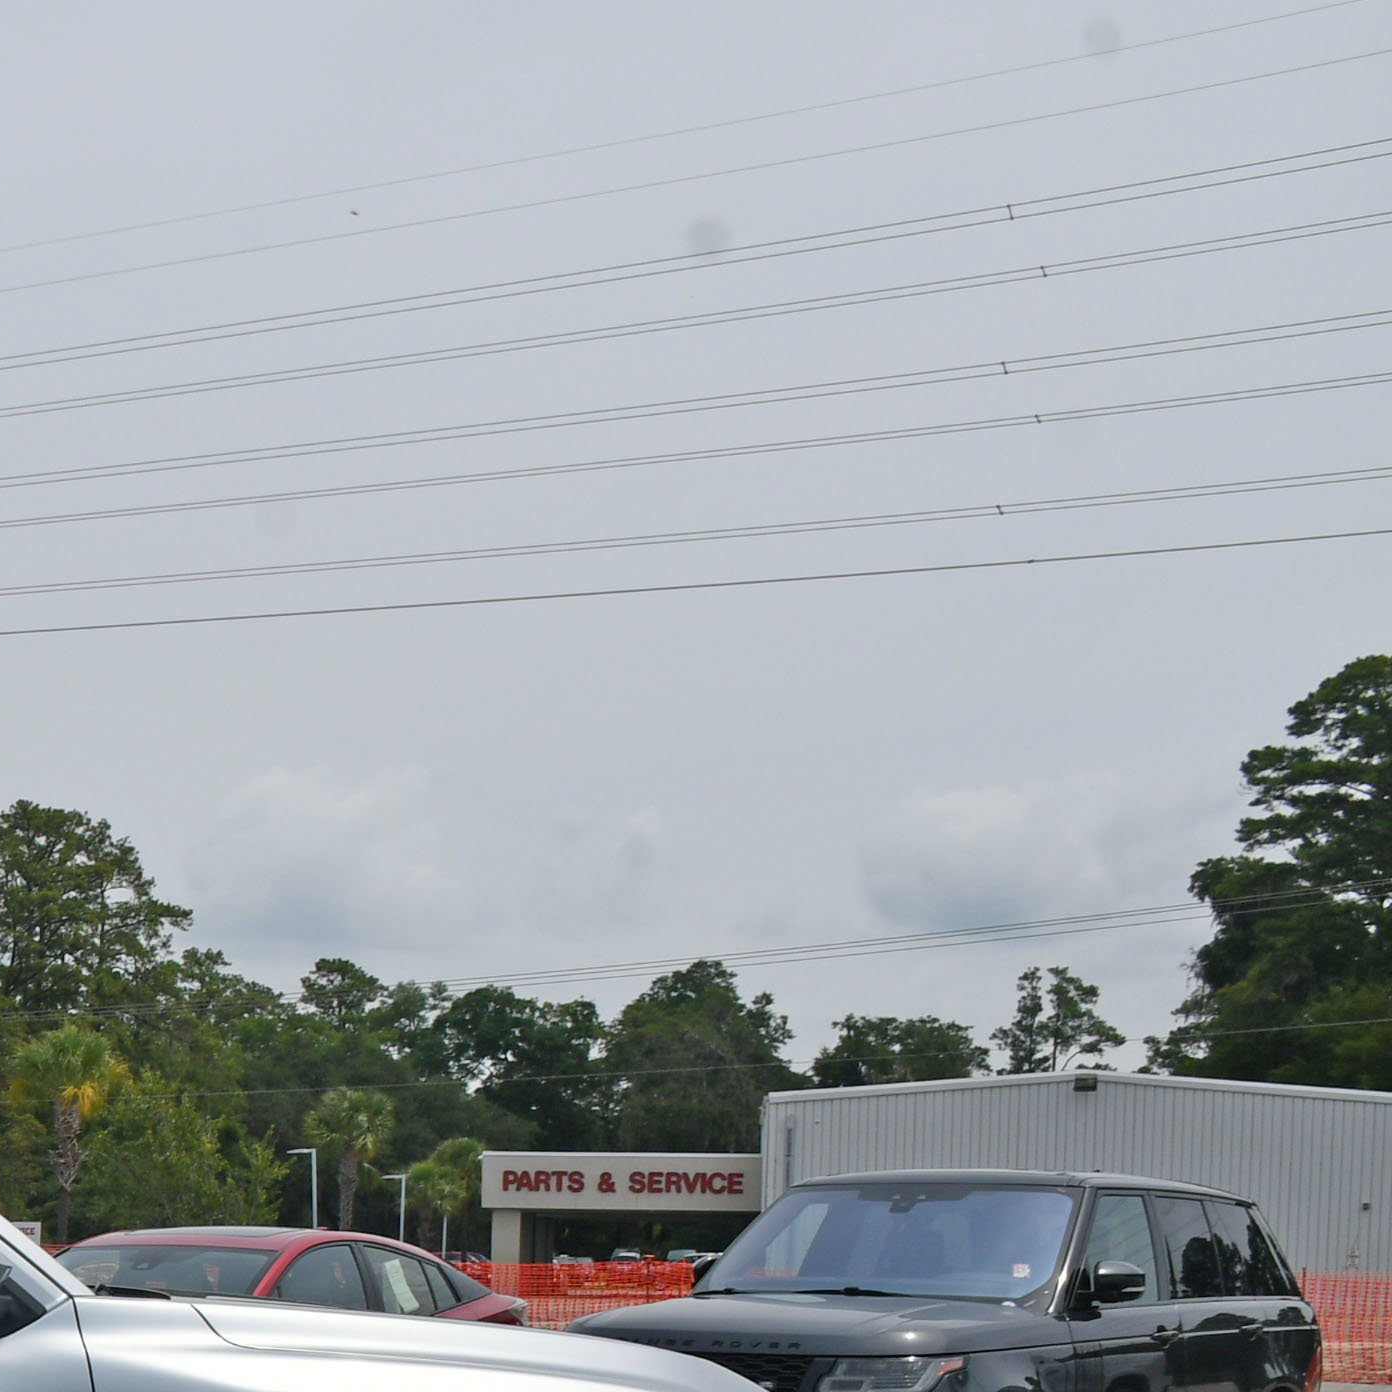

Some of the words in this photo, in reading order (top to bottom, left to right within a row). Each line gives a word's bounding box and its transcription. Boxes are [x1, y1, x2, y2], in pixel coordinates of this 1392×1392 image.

[502, 1170, 585, 1192] PARTS
[597, 1172, 616, 1193] &
[628, 1172, 744, 1194] SERVICE
[712, 1340, 800, 1350] ROVER
